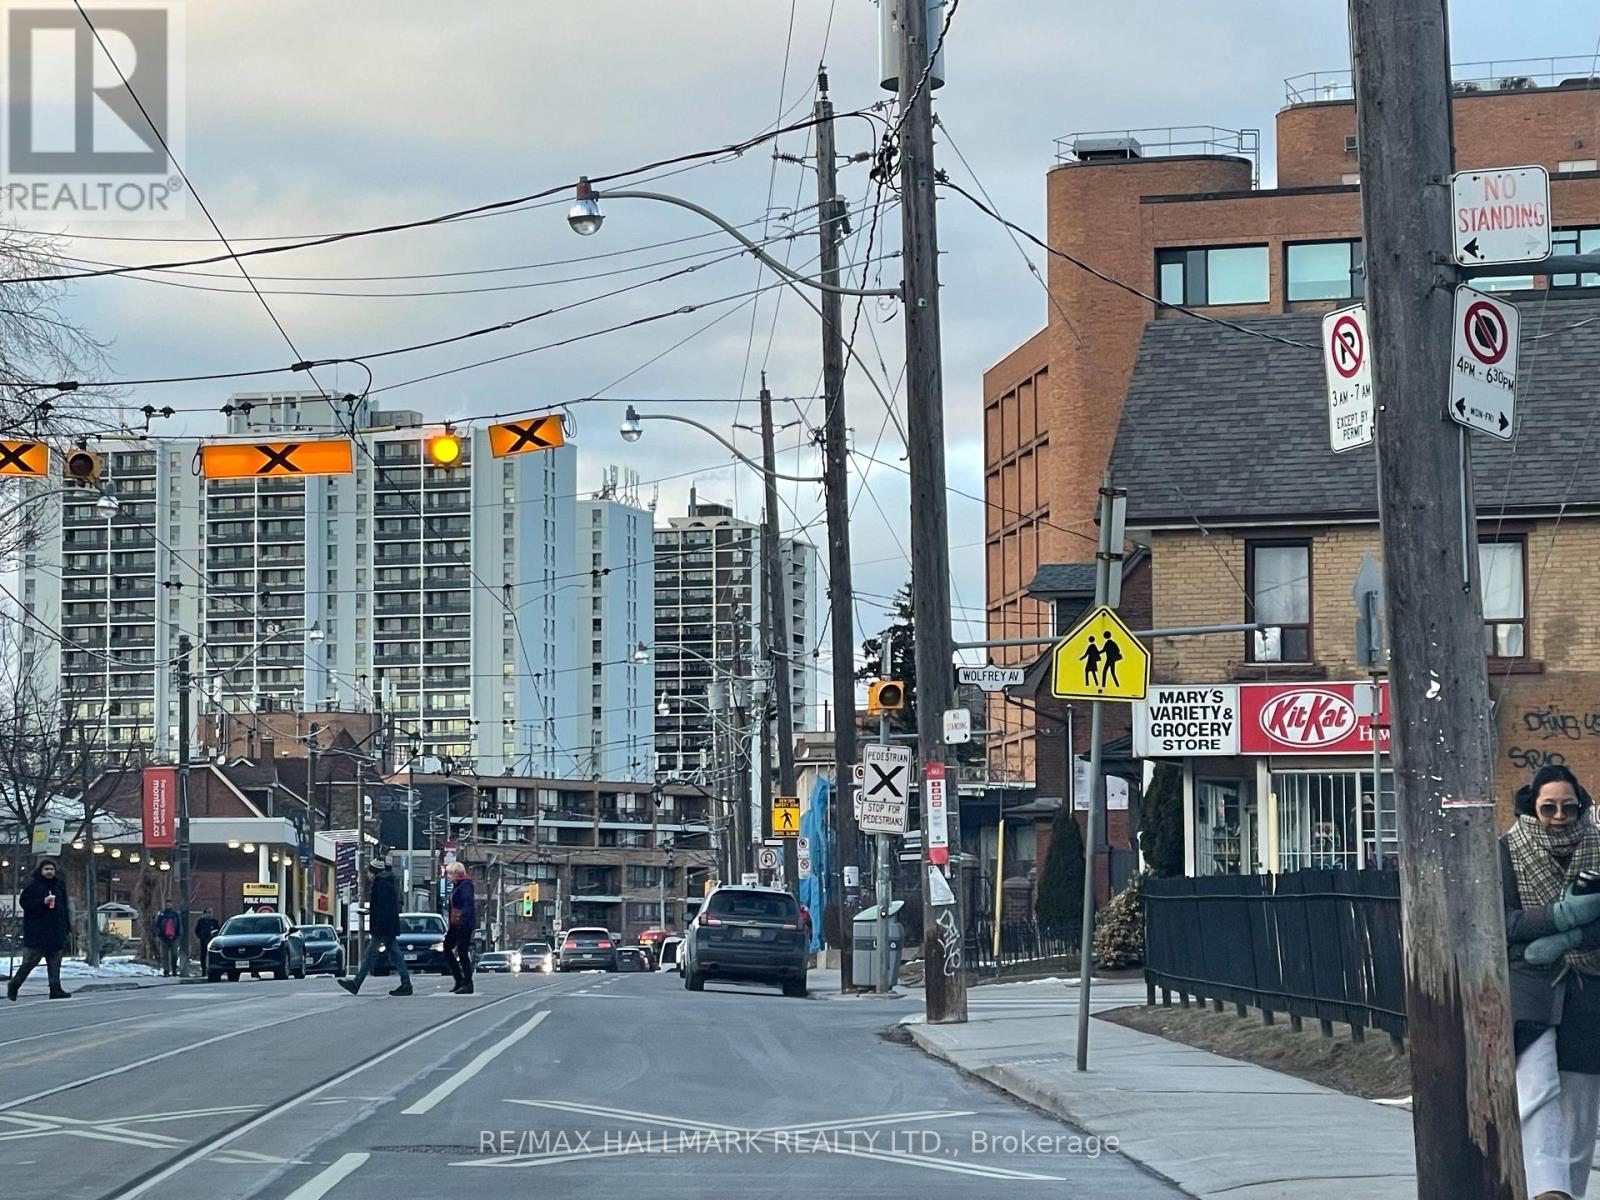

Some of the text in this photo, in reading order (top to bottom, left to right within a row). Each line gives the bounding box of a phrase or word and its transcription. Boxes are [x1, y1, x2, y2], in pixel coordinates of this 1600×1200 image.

[1484, 174, 1516, 201] NO
[1458, 202, 1545, 233] STANDING
[1456, 356, 1476, 377] 4PM
[1336, 409, 1368, 429] EXCEPT BY
[1342, 425, 1364, 439] PERMIT
[963, 670, 1019, 682] WOLFREY AV
[1159, 688, 1224, 704] MARY'S
[1150, 705, 1233, 720] VARIETY &
[1151, 722, 1232, 737] GROCERY
[1162, 739, 1221, 750] STORE
[867, 750, 908, 763] PEDESTRIAN
[867, 803, 901, 814] STOP FOR
[862, 814, 904, 827] PEDESTRIANS
